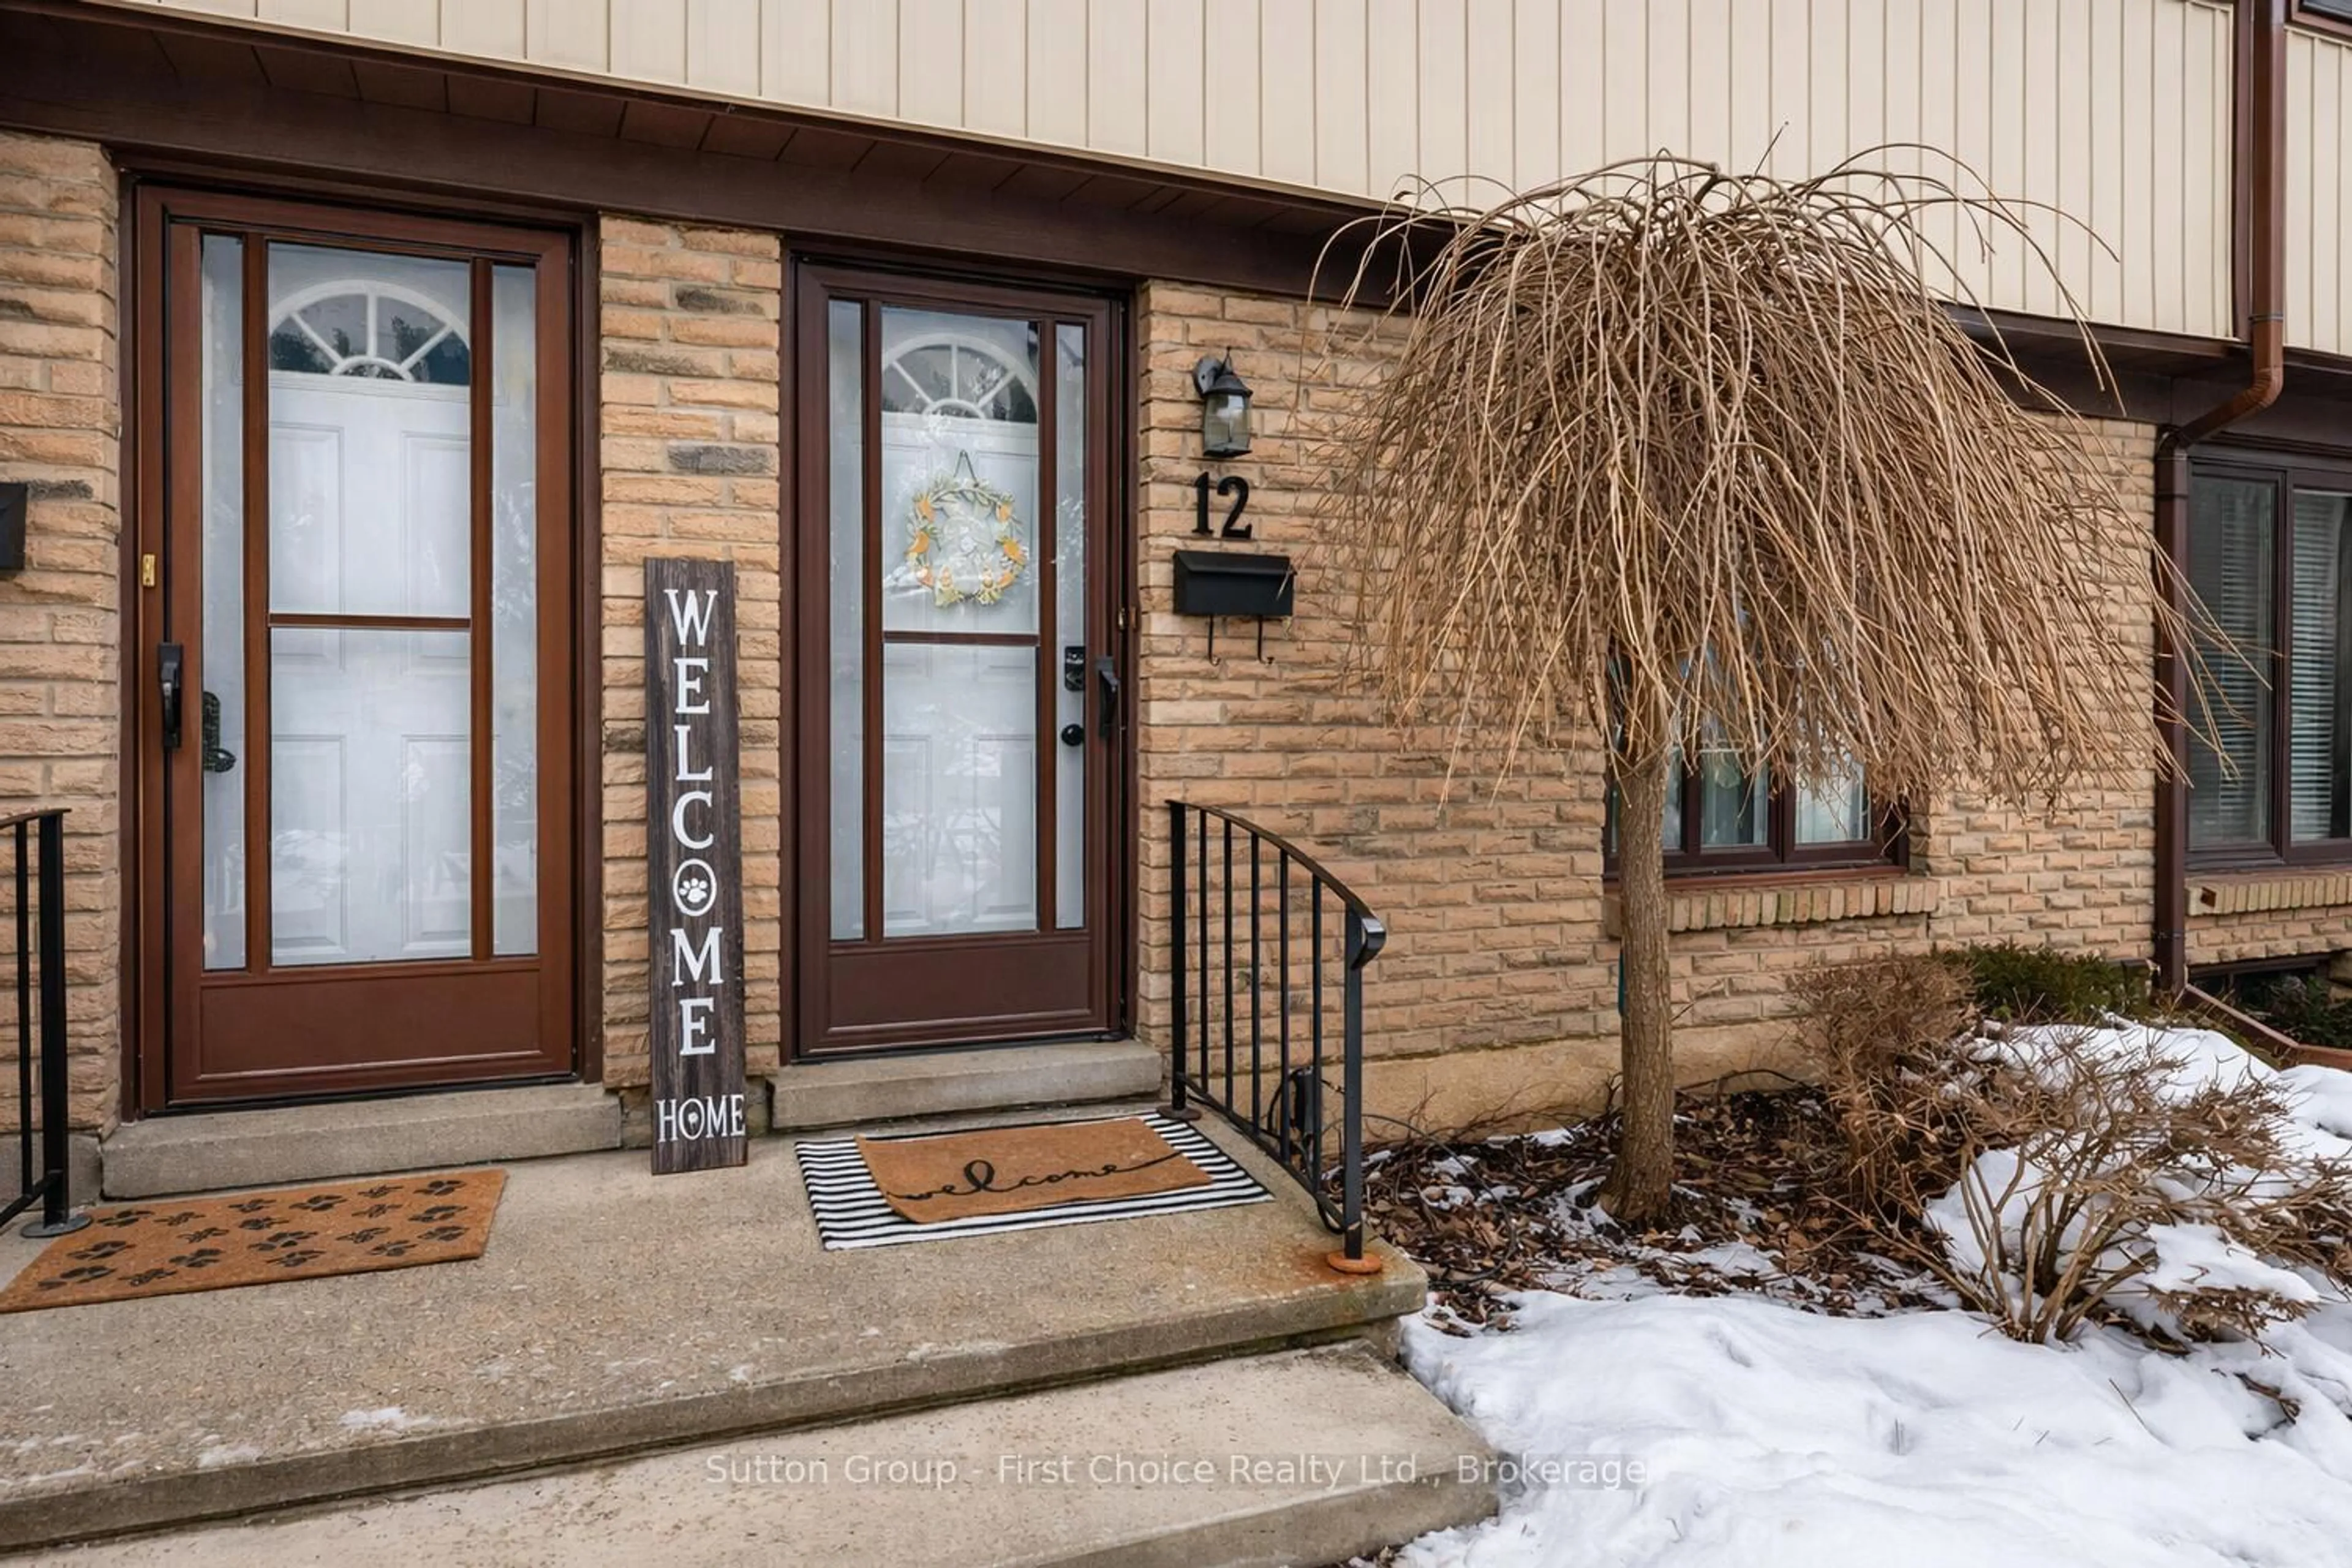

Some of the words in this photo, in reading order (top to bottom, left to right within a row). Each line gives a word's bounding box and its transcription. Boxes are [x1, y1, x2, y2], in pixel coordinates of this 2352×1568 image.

[1191, 472, 1252, 540] 12
[664, 589, 723, 1055] WELCOME
[655, 1094, 746, 1144] HOME
[885, 1151, 1183, 1200] welcome
